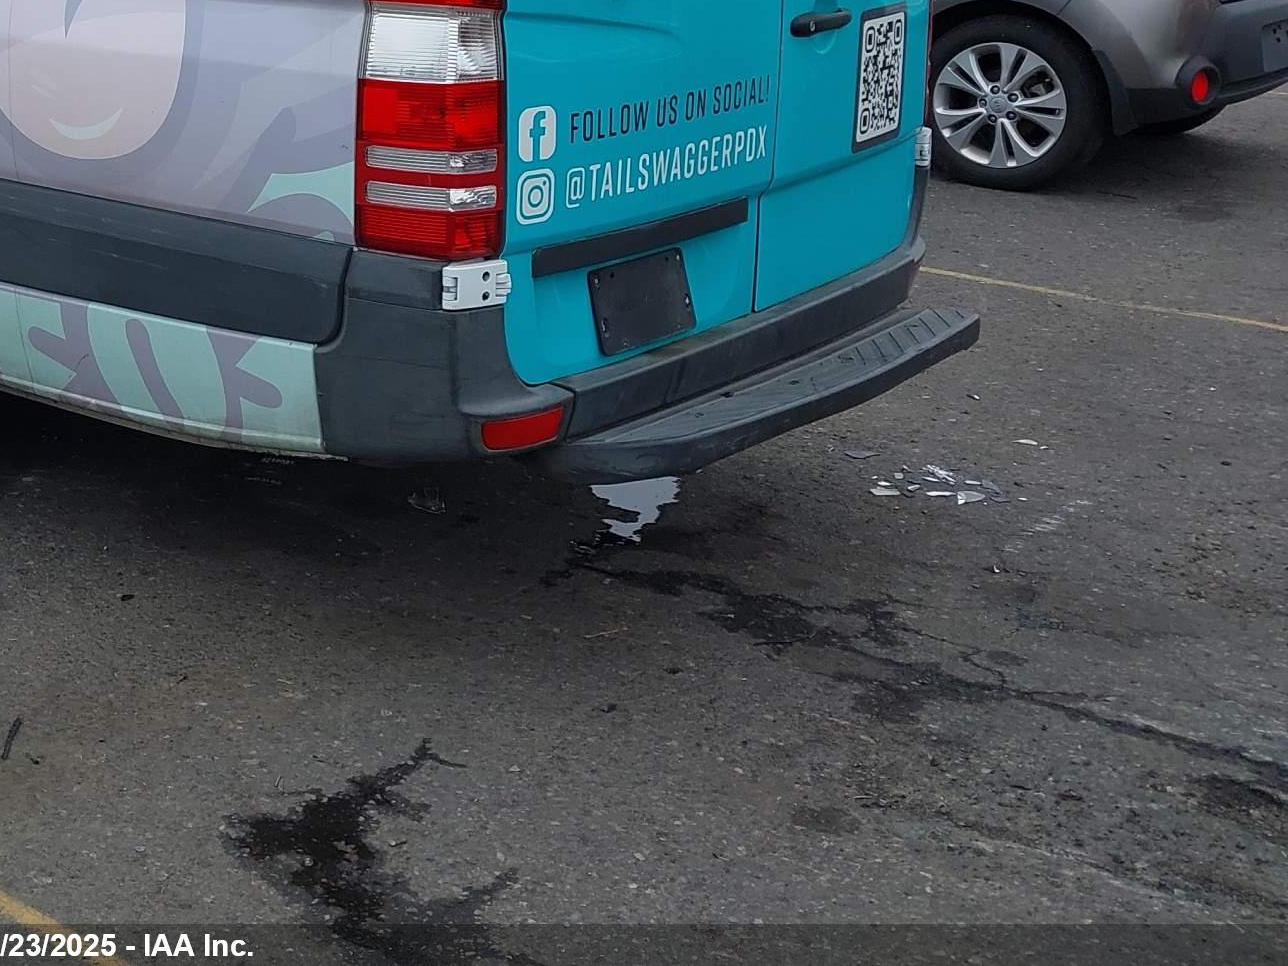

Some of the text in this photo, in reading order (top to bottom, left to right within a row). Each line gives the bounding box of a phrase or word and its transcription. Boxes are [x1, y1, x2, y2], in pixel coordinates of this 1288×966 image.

[570, 75, 771, 144] FOLLOW US ON SOCIAL!
[565, 124, 768, 209] @TAILSWAGGERPDX
